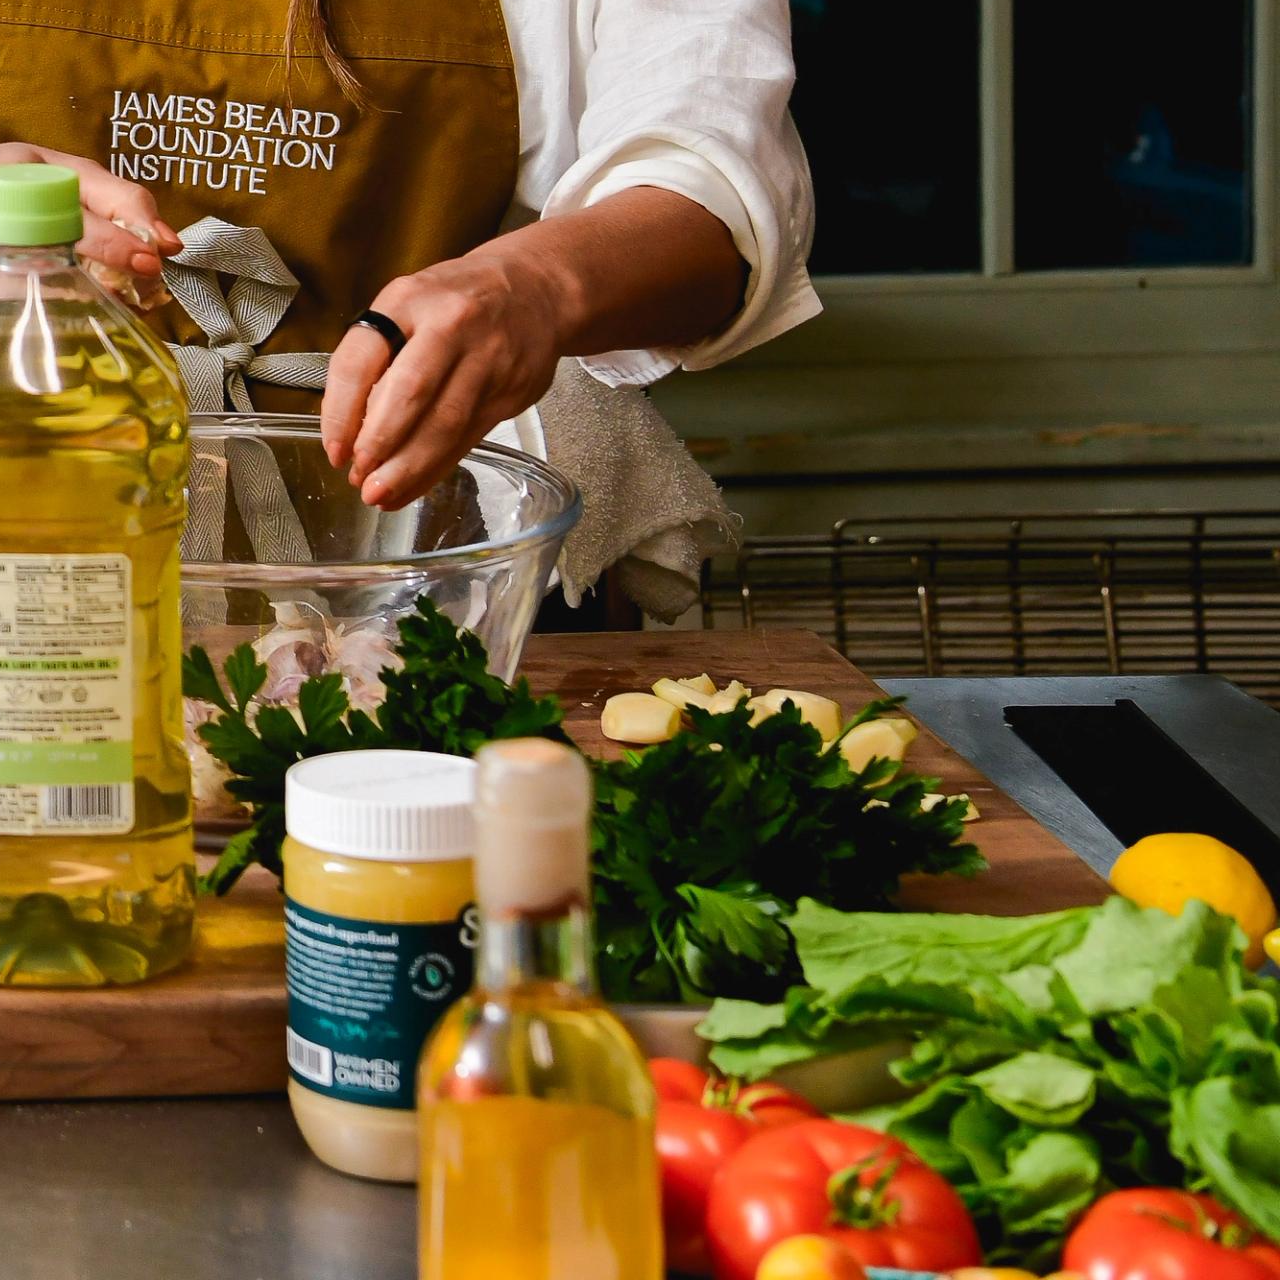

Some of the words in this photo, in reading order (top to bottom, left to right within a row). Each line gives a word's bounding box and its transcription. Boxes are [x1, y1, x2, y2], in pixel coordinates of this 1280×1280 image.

[109, 90, 216, 126] JAMES
[223, 101, 341, 139] BEARD
[109, 120, 336, 171] FOUNDATION
[110, 153, 268, 195] INSTITUTE
[334, 1066, 401, 1093] OWNED
